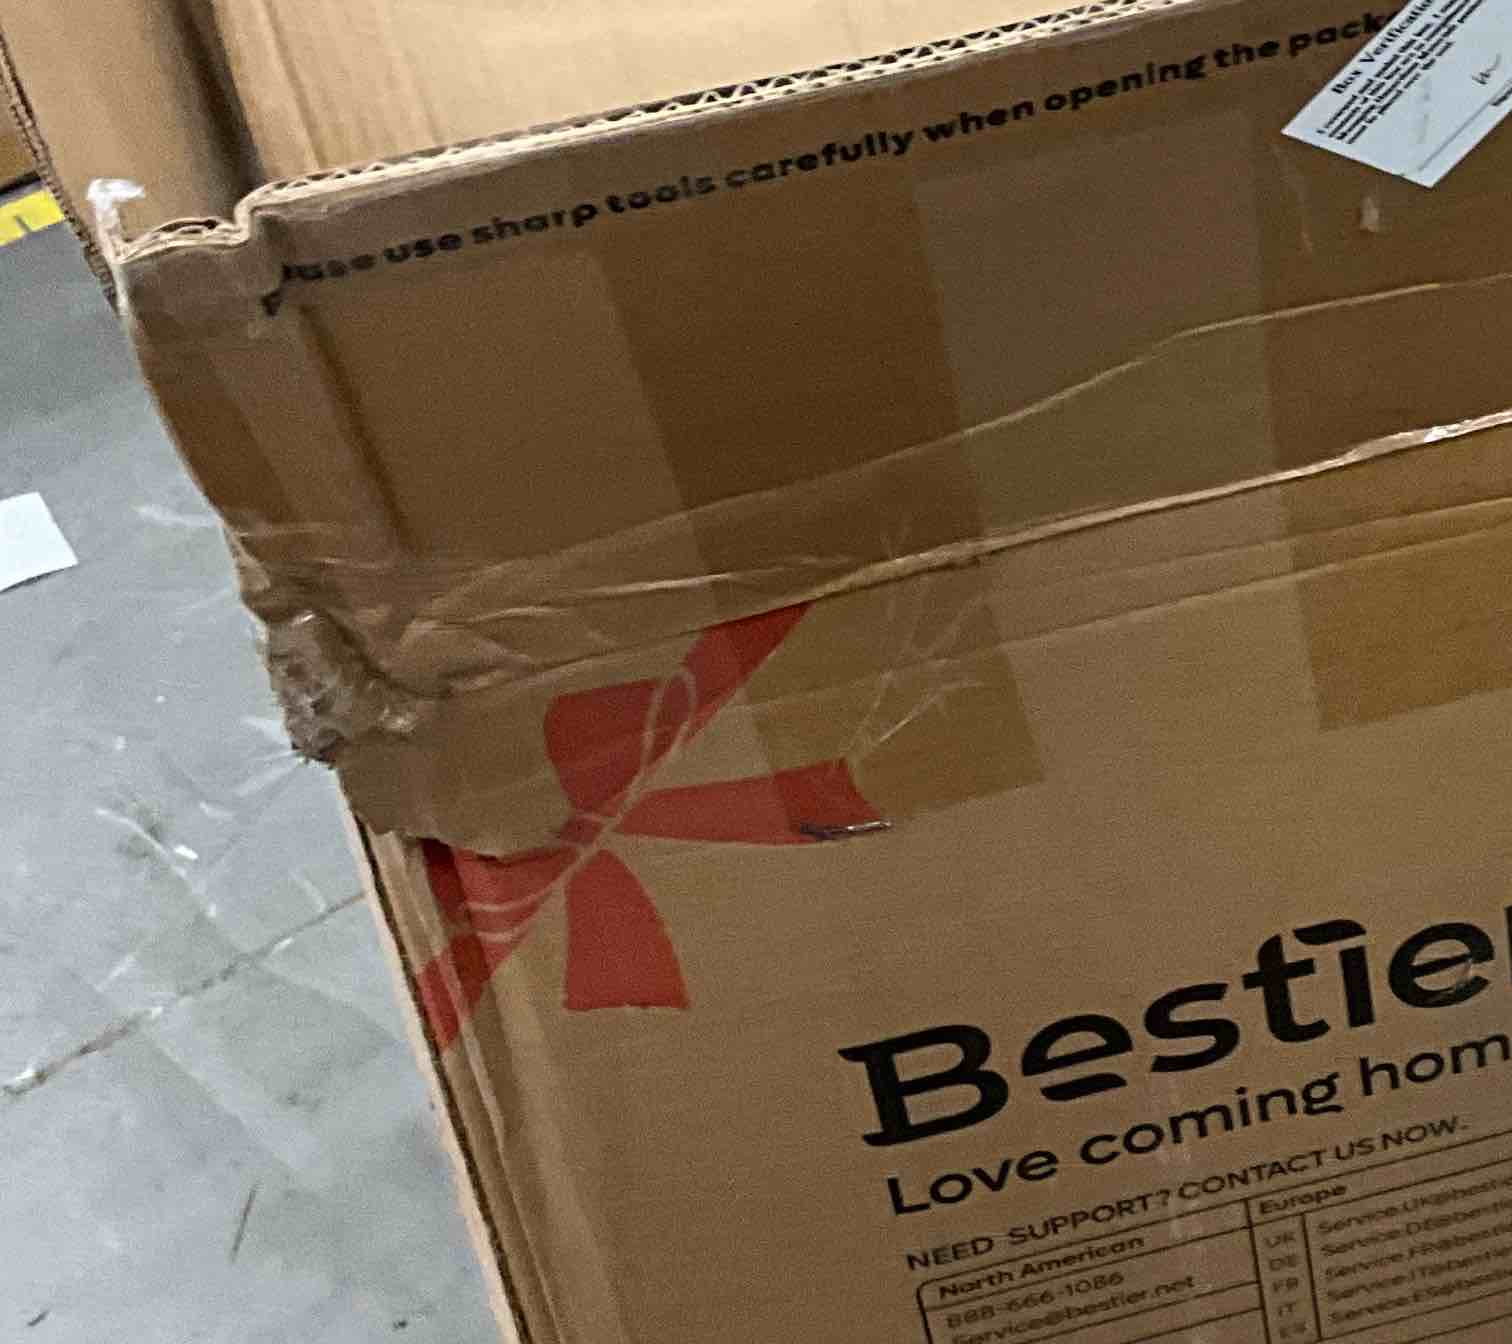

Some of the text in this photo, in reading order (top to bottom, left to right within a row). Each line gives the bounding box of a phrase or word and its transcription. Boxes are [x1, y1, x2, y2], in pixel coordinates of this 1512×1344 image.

[1331, 69, 1363, 94] Box
[384, 231, 462, 263] use
[471, 201, 600, 244] sharp
[607, 175, 716, 214] tools
[725, 126, 916, 189] carefully
[922, 93, 1035, 144] when
[1044, 56, 1208, 114] opening
[1213, 35, 1281, 69] the
[886, 1148, 1059, 1216] Love
[1079, 1071, 1345, 1166] coming
[906, 1236, 995, 1272] NEED
[1007, 1186, 1173, 1246] SUPPORT?
[1177, 1149, 1328, 1199] CONTACT
[1334, 1136, 1376, 1162] US
[1258, 1183, 1348, 1215] Europe
[938, 1235, 1146, 1300] North American
